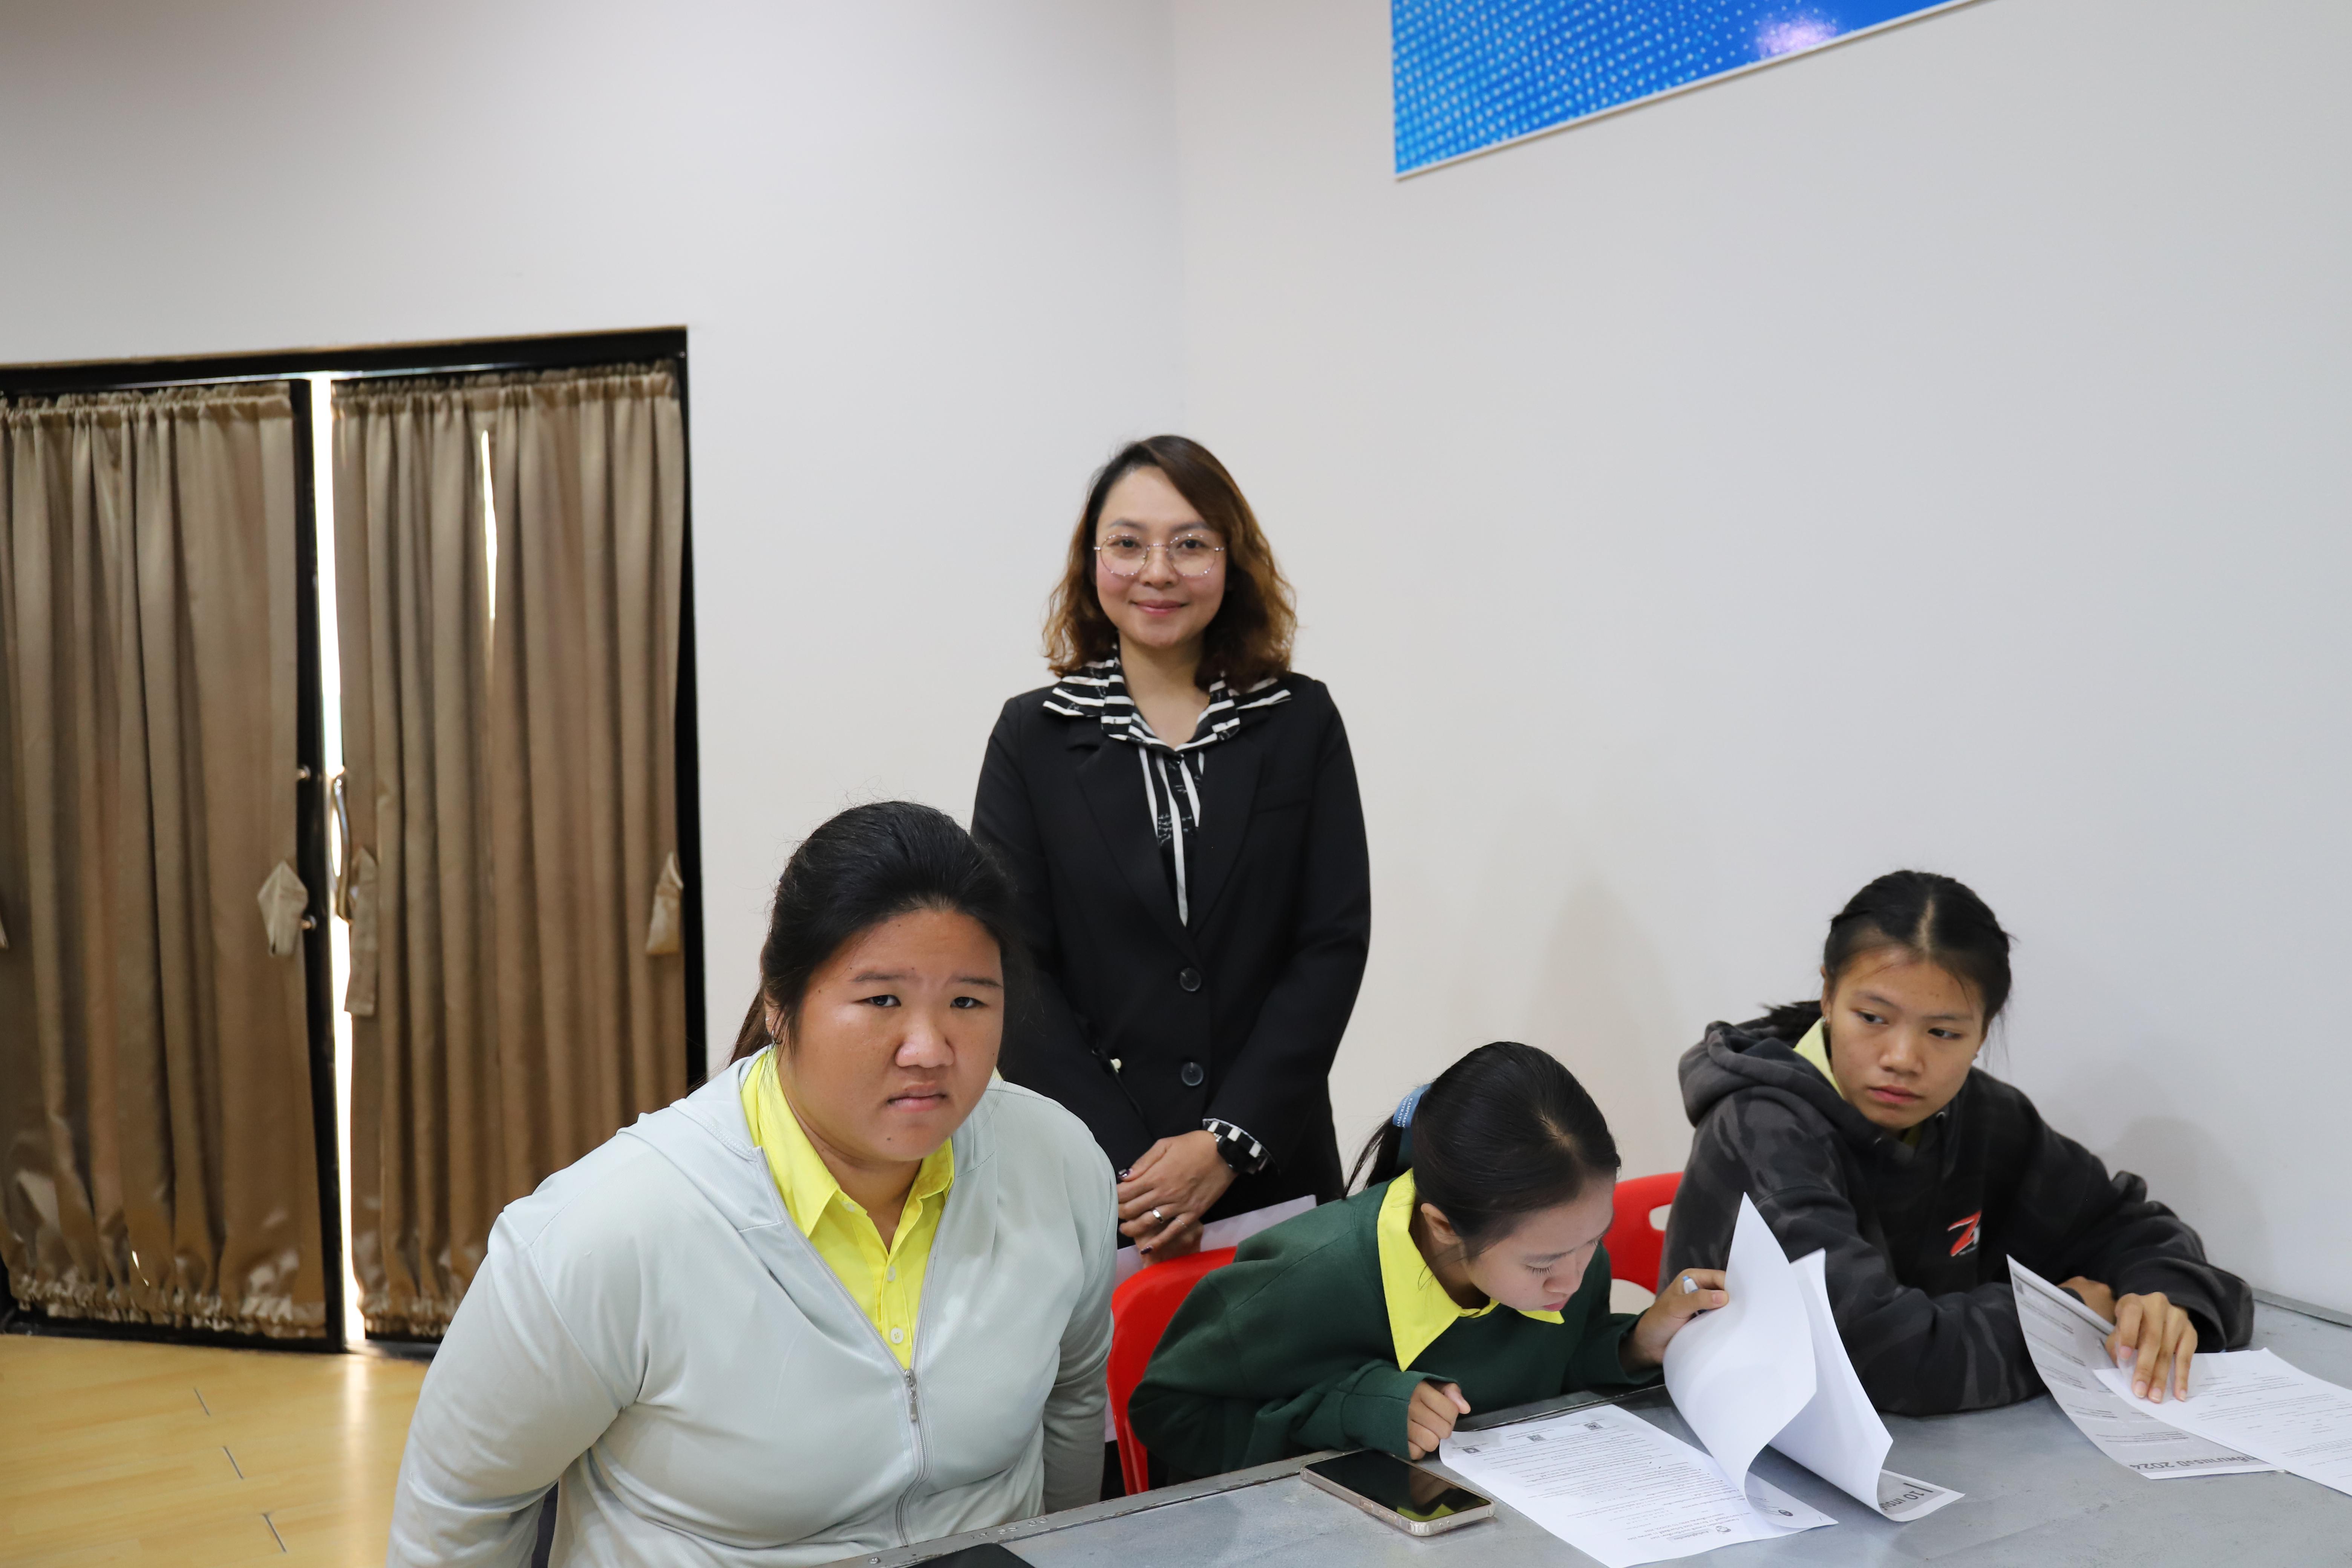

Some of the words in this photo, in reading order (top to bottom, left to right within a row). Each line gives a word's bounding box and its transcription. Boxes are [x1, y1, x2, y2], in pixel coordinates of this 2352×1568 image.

[2129, 1462, 2174, 1470] 2024
[2176, 1456, 2256, 1467] าชีพมาแรงปี
[1903, 1491, 1925, 1500] 10
